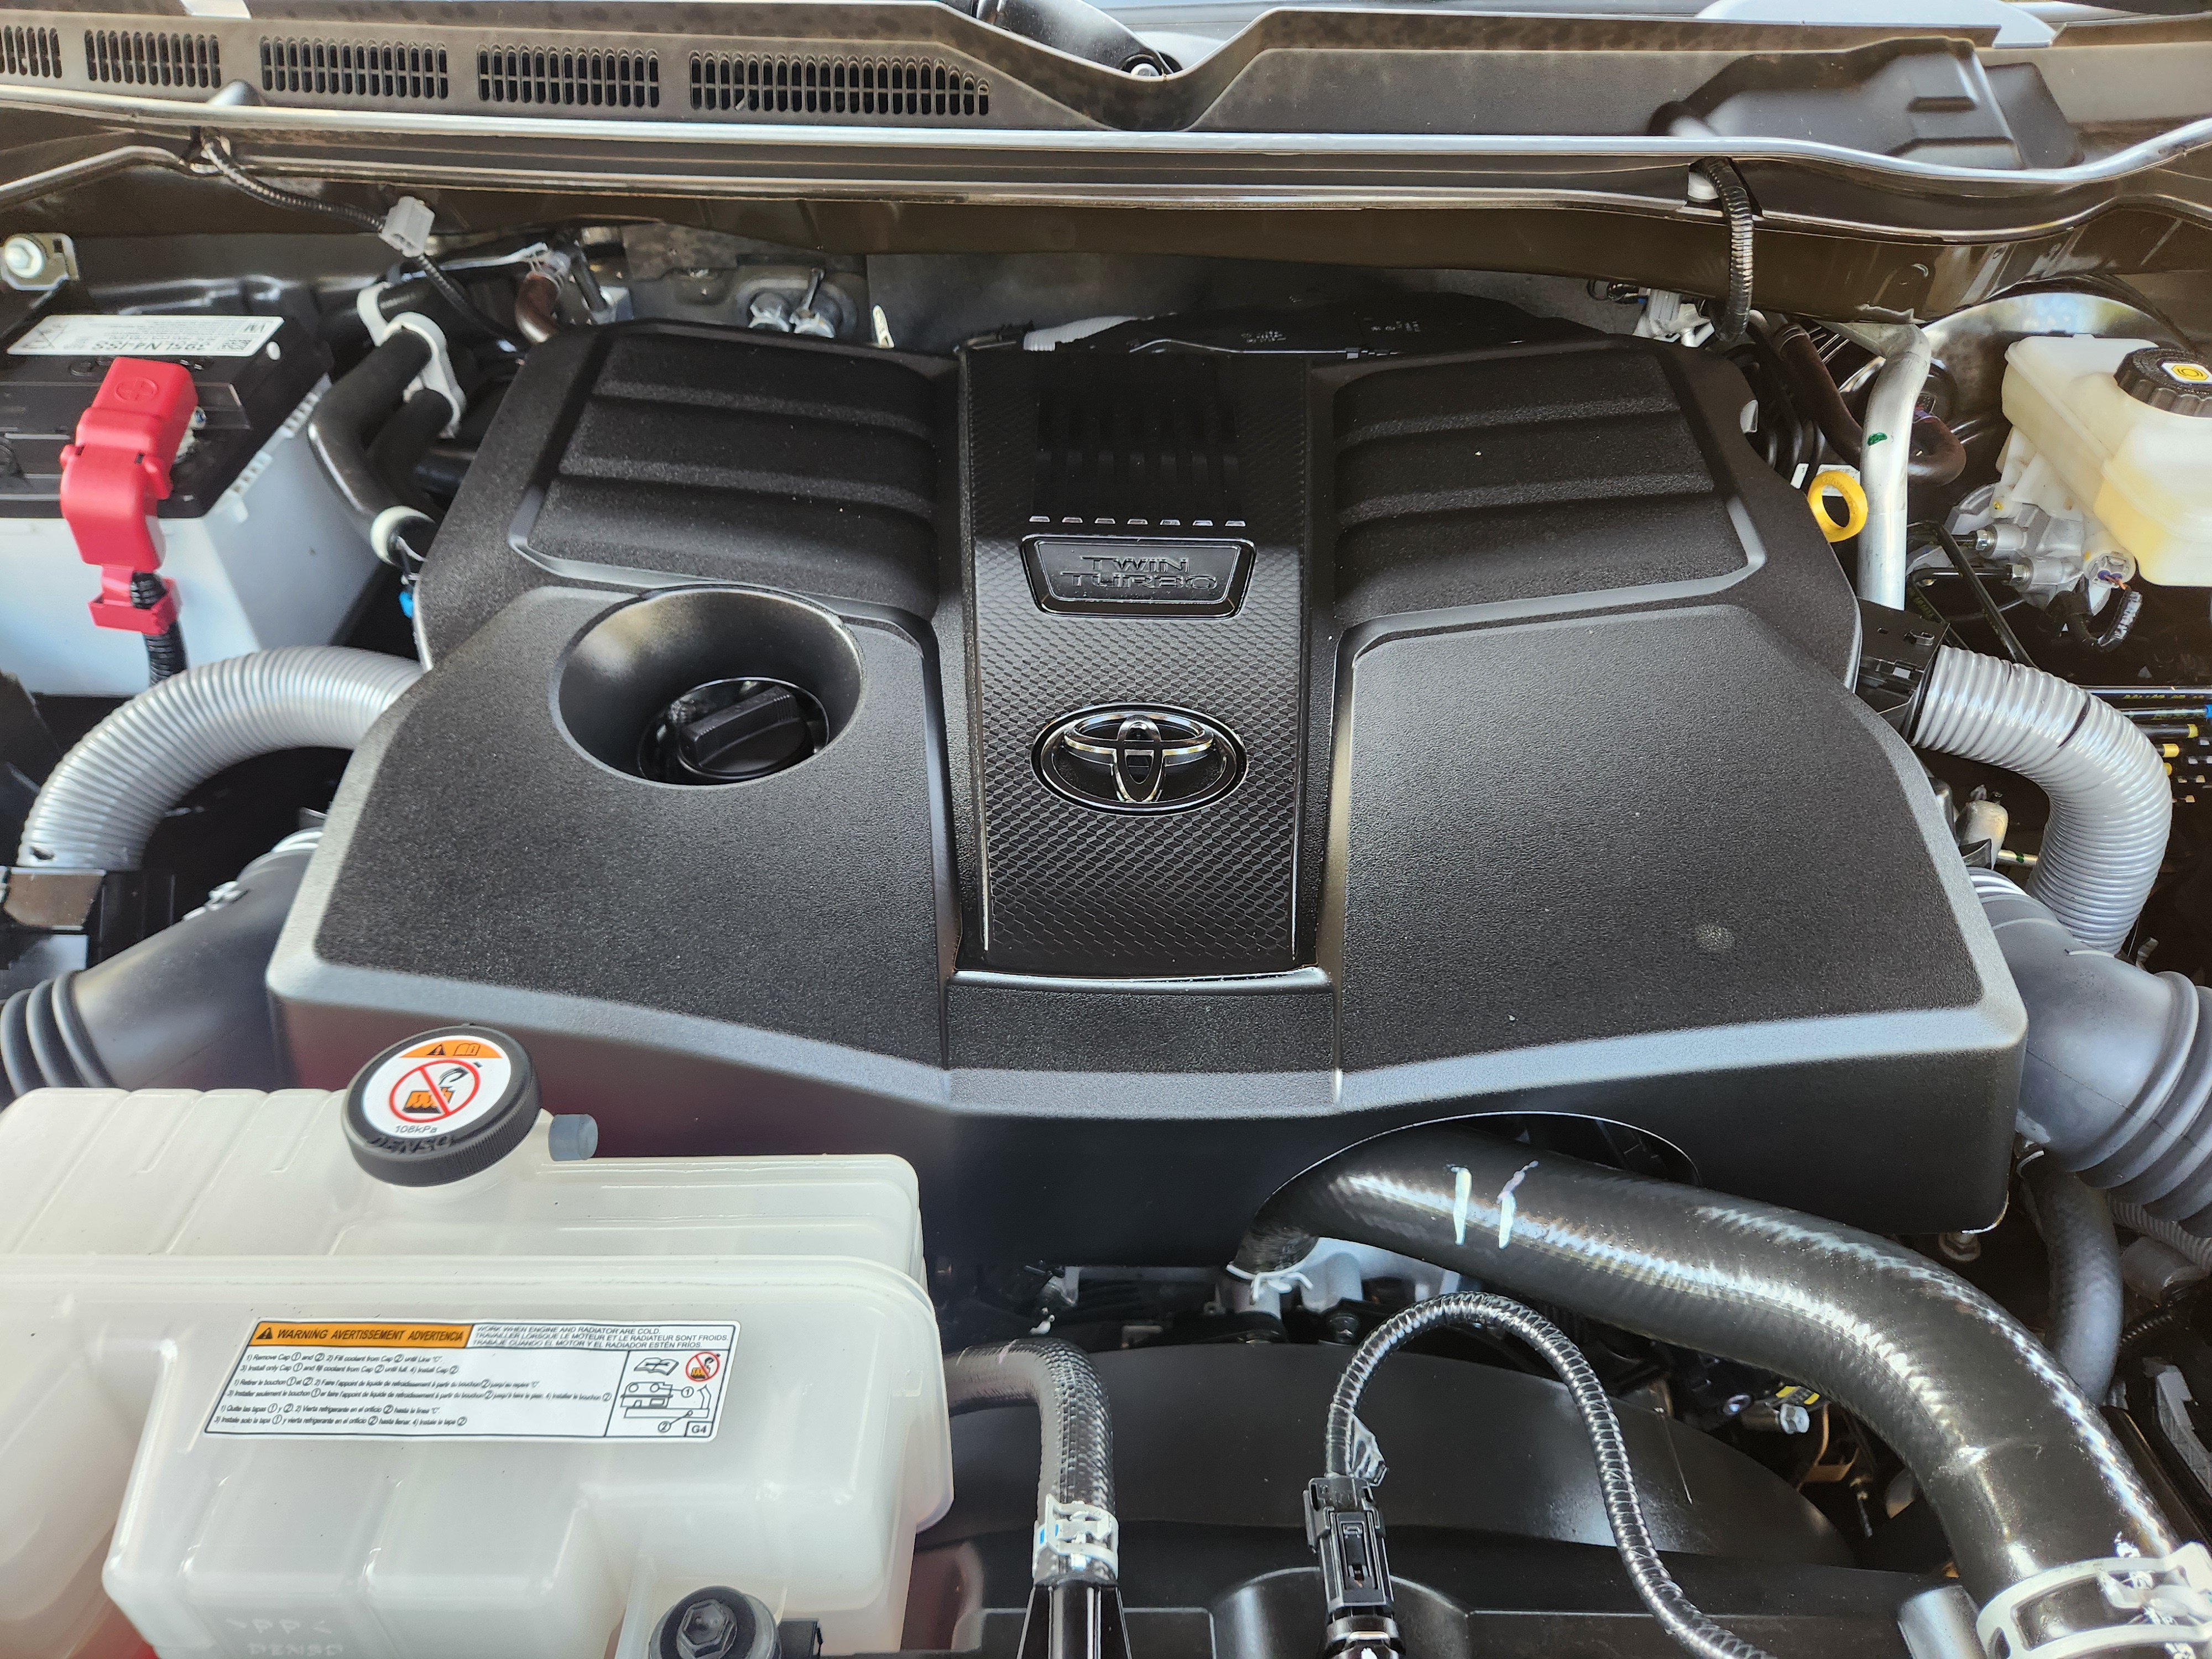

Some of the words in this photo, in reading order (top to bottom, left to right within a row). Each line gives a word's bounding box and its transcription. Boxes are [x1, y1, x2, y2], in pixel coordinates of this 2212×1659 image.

[1079, 555, 1189, 572] TWIN
[1060, 572, 1218, 589] TURBO
[395, 1125, 438, 1133] 108kPa
[277, 1329, 328, 1339] WARNING
[331, 1329, 406, 1340] AVERTISSEMENT
[408, 1331, 464, 1341] ADVERTENCIA
[361, 1365, 373, 1374] Cap
[691, 1425, 707, 1433] G4
